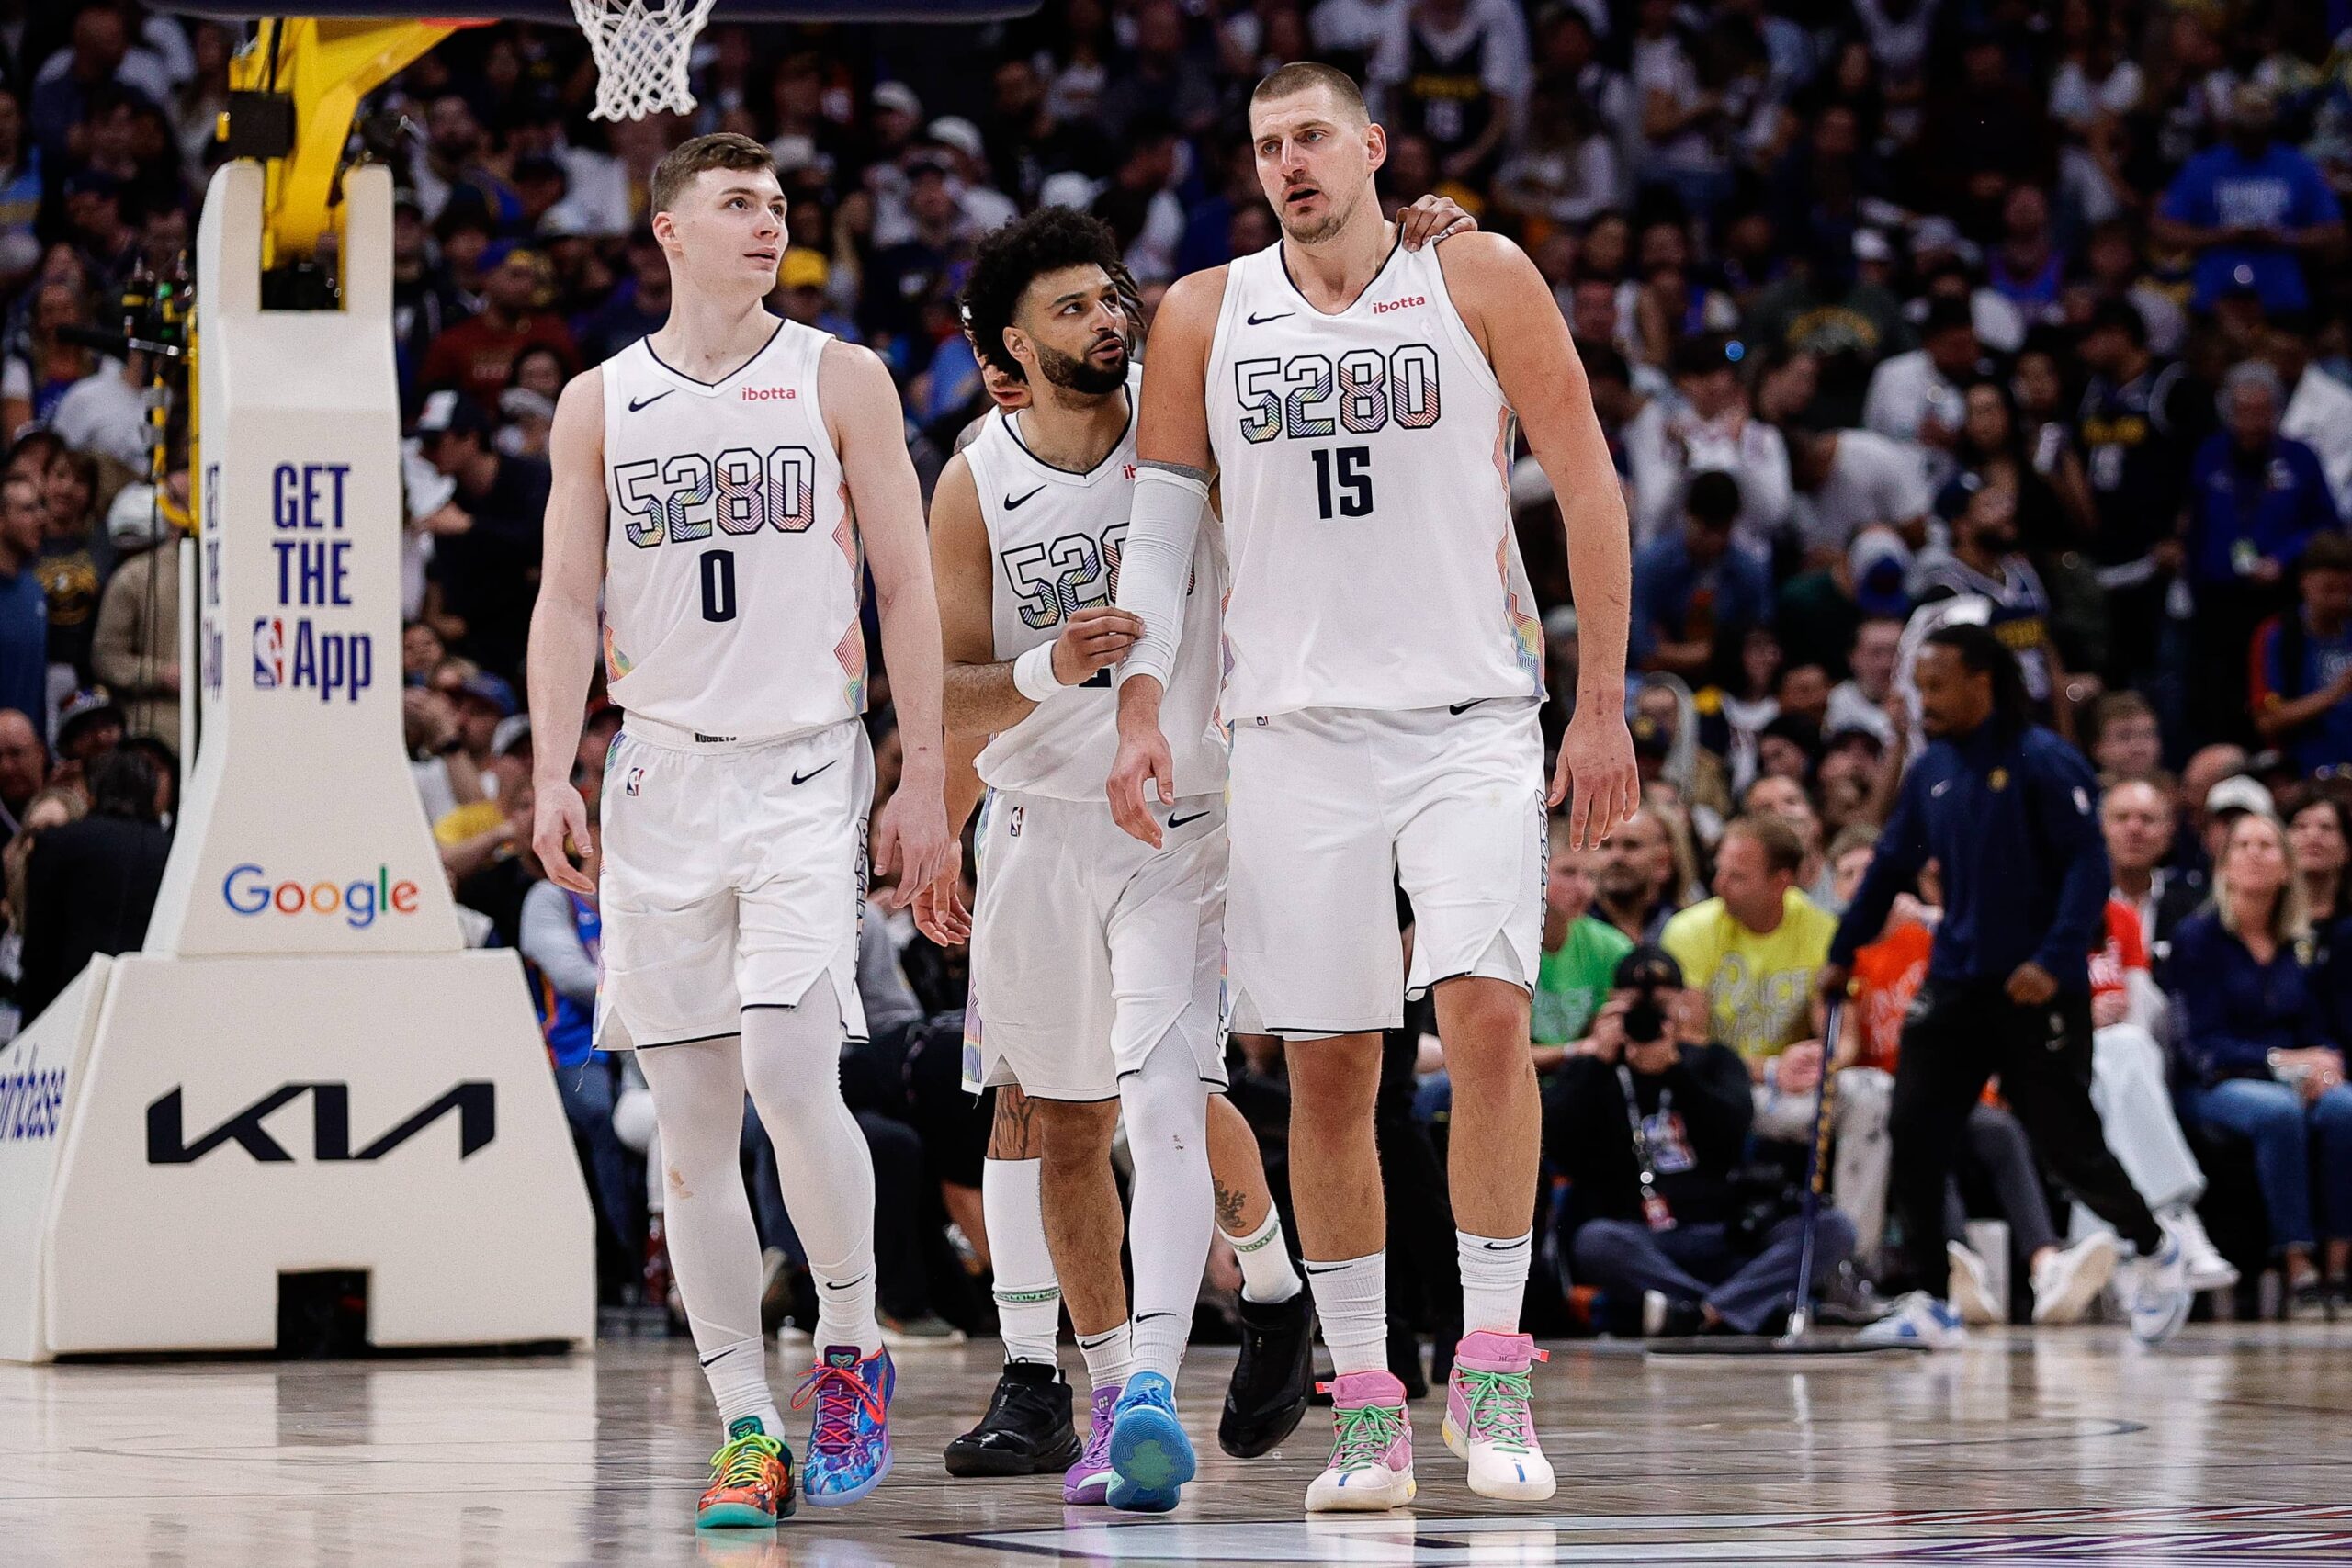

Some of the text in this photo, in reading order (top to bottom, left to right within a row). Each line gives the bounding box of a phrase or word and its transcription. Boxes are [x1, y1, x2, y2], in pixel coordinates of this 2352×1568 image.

[1373, 295, 1426, 315] ibotta
[742, 387, 797, 401] ibotta
[1235, 343, 1442, 445] 5280
[273, 463, 351, 529] GET
[614, 446, 816, 549] 5280
[1311, 446, 1374, 520] 15
[272, 539, 353, 605] THE
[700, 548, 737, 623] 0
[292, 618, 372, 703] App
[222, 863, 419, 929] Google
[147, 1082, 495, 1164] KIA
